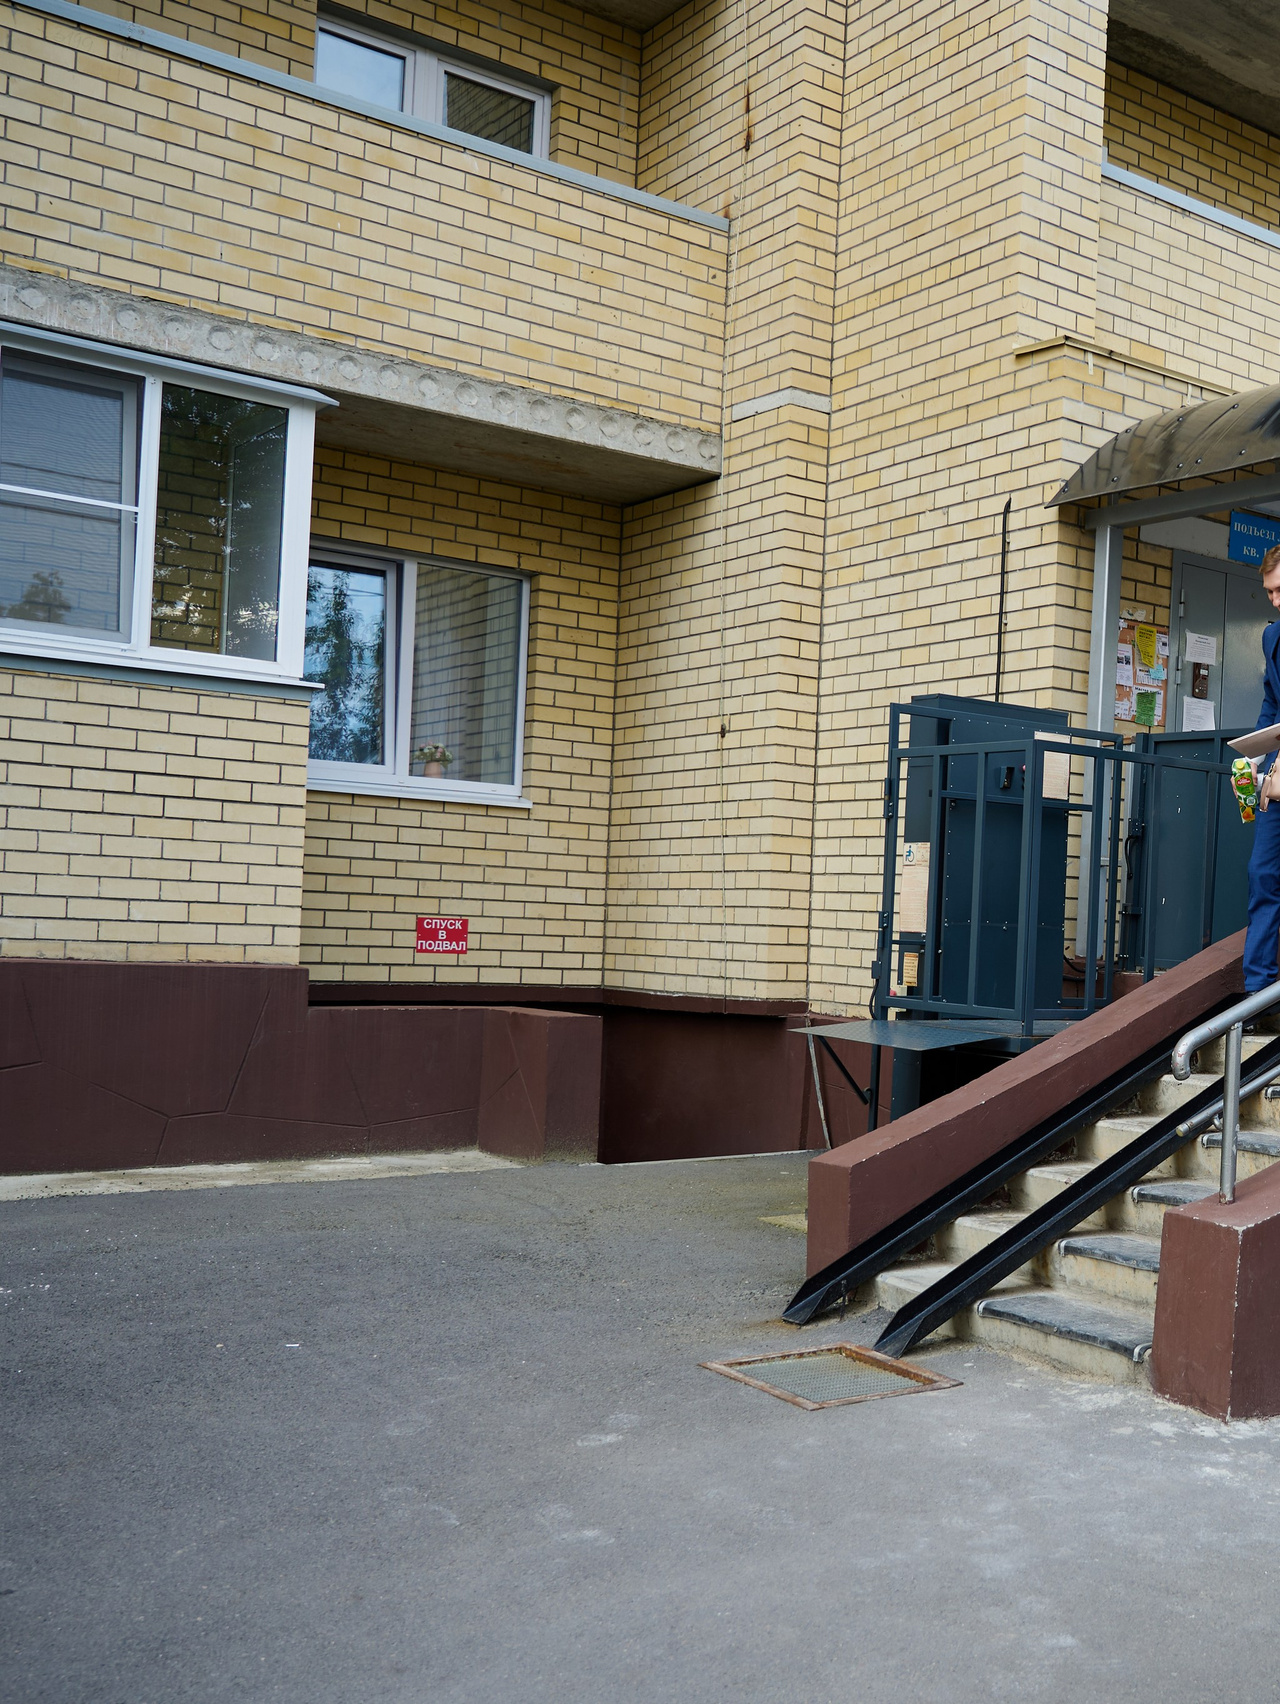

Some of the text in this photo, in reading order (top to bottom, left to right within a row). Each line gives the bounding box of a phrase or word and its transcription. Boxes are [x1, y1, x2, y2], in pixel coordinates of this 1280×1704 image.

[1233, 521, 1276, 542] подъезд
[1242, 545, 1260, 558] кв.
[423, 919, 463, 930] СПУСК
[438, 930, 447, 940] В
[417, 940, 467, 952] ПОДВАЛ
